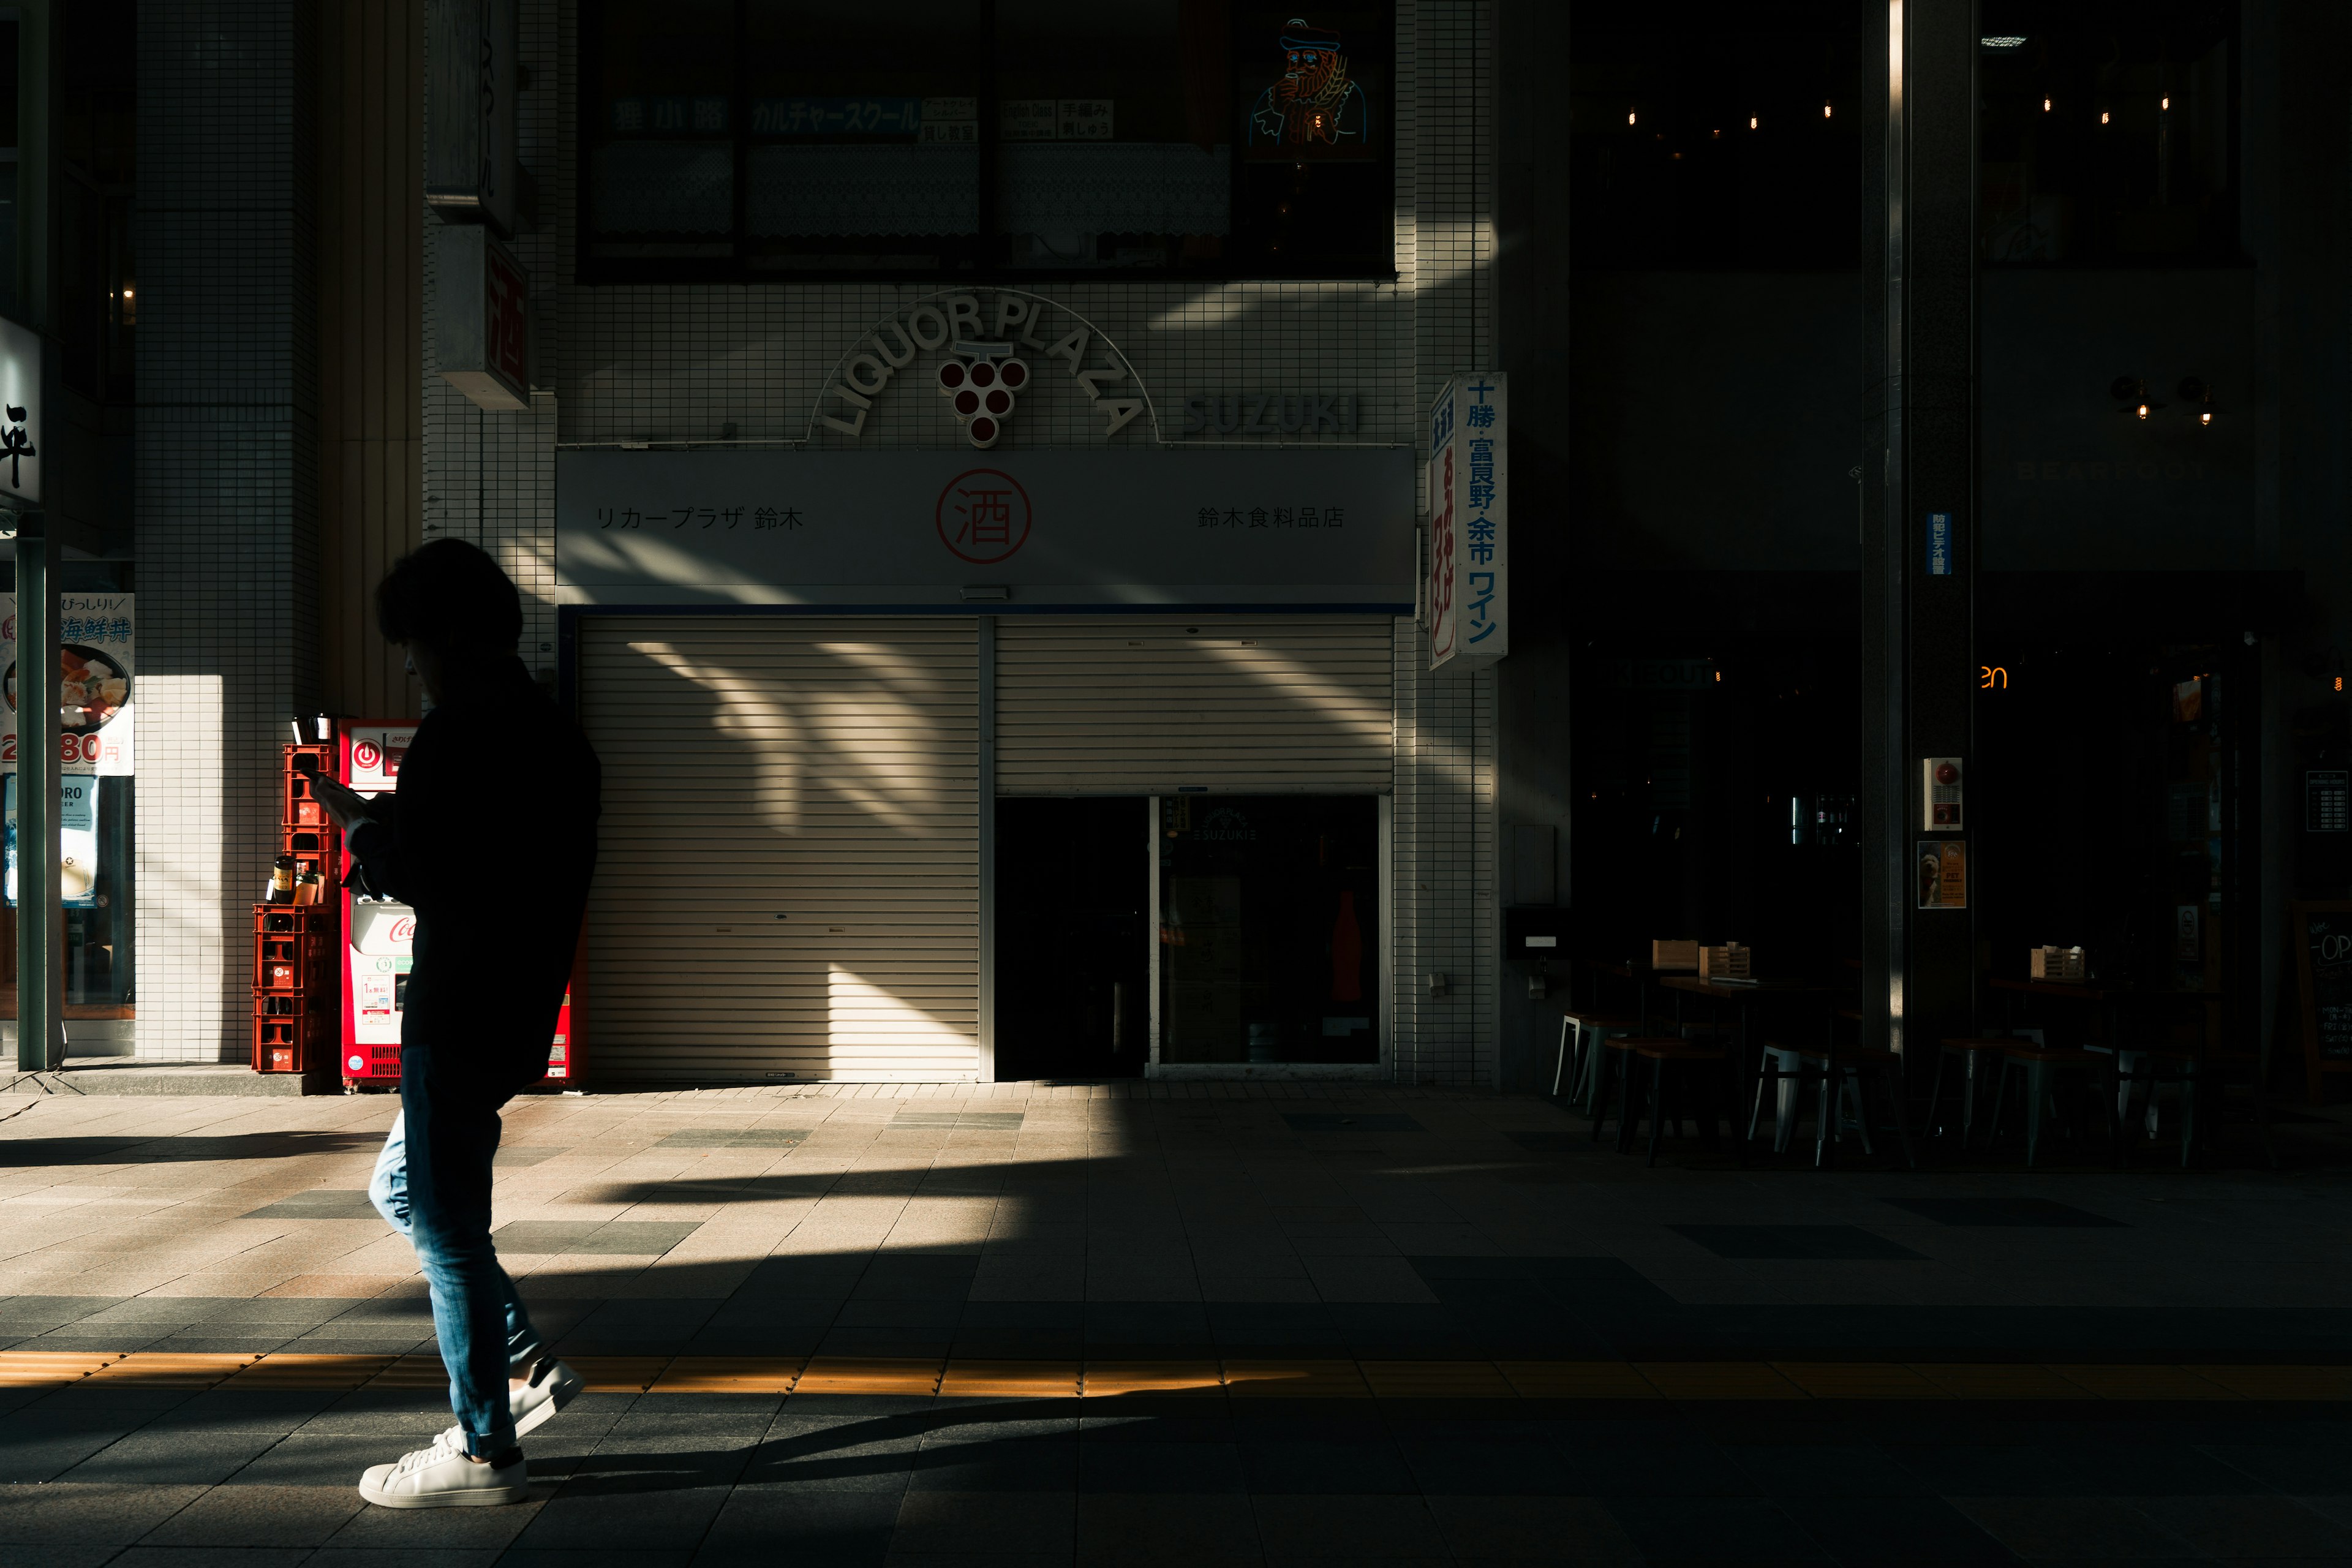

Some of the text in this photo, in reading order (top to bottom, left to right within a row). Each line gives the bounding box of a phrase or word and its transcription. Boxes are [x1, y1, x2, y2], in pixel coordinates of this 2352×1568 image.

[615, 99, 723, 130] 狸小路
[752, 100, 919, 133] カルチャースクール
[1004, 102, 1052, 119] English Class
[1063, 103, 1108, 118] 手編み
[924, 125, 978, 142] 貸し教室
[1063, 121, 1109, 135] 刺しゅう
[490, 255, 525, 387] 酒
[820, 295, 1145, 437] LIQUOR PLAZA
[1182, 394, 1358, 432] SUZUKI
[2018, 460, 2209, 480] BEARFOOT
[597, 505, 804, 531] リカープラザ 鈴木
[954, 487, 1013, 546] 酒
[1197, 507, 1344, 529] 鈴木食料品店
[1466, 380, 1496, 644] 十勝・富良野・余市 ワイン
[1932, 514, 1946, 575] 防犯ビデオ設置
[1201, 807, 1249, 829] LIQUOR PLAZA
[1202, 829, 1248, 840] SUZUKI
